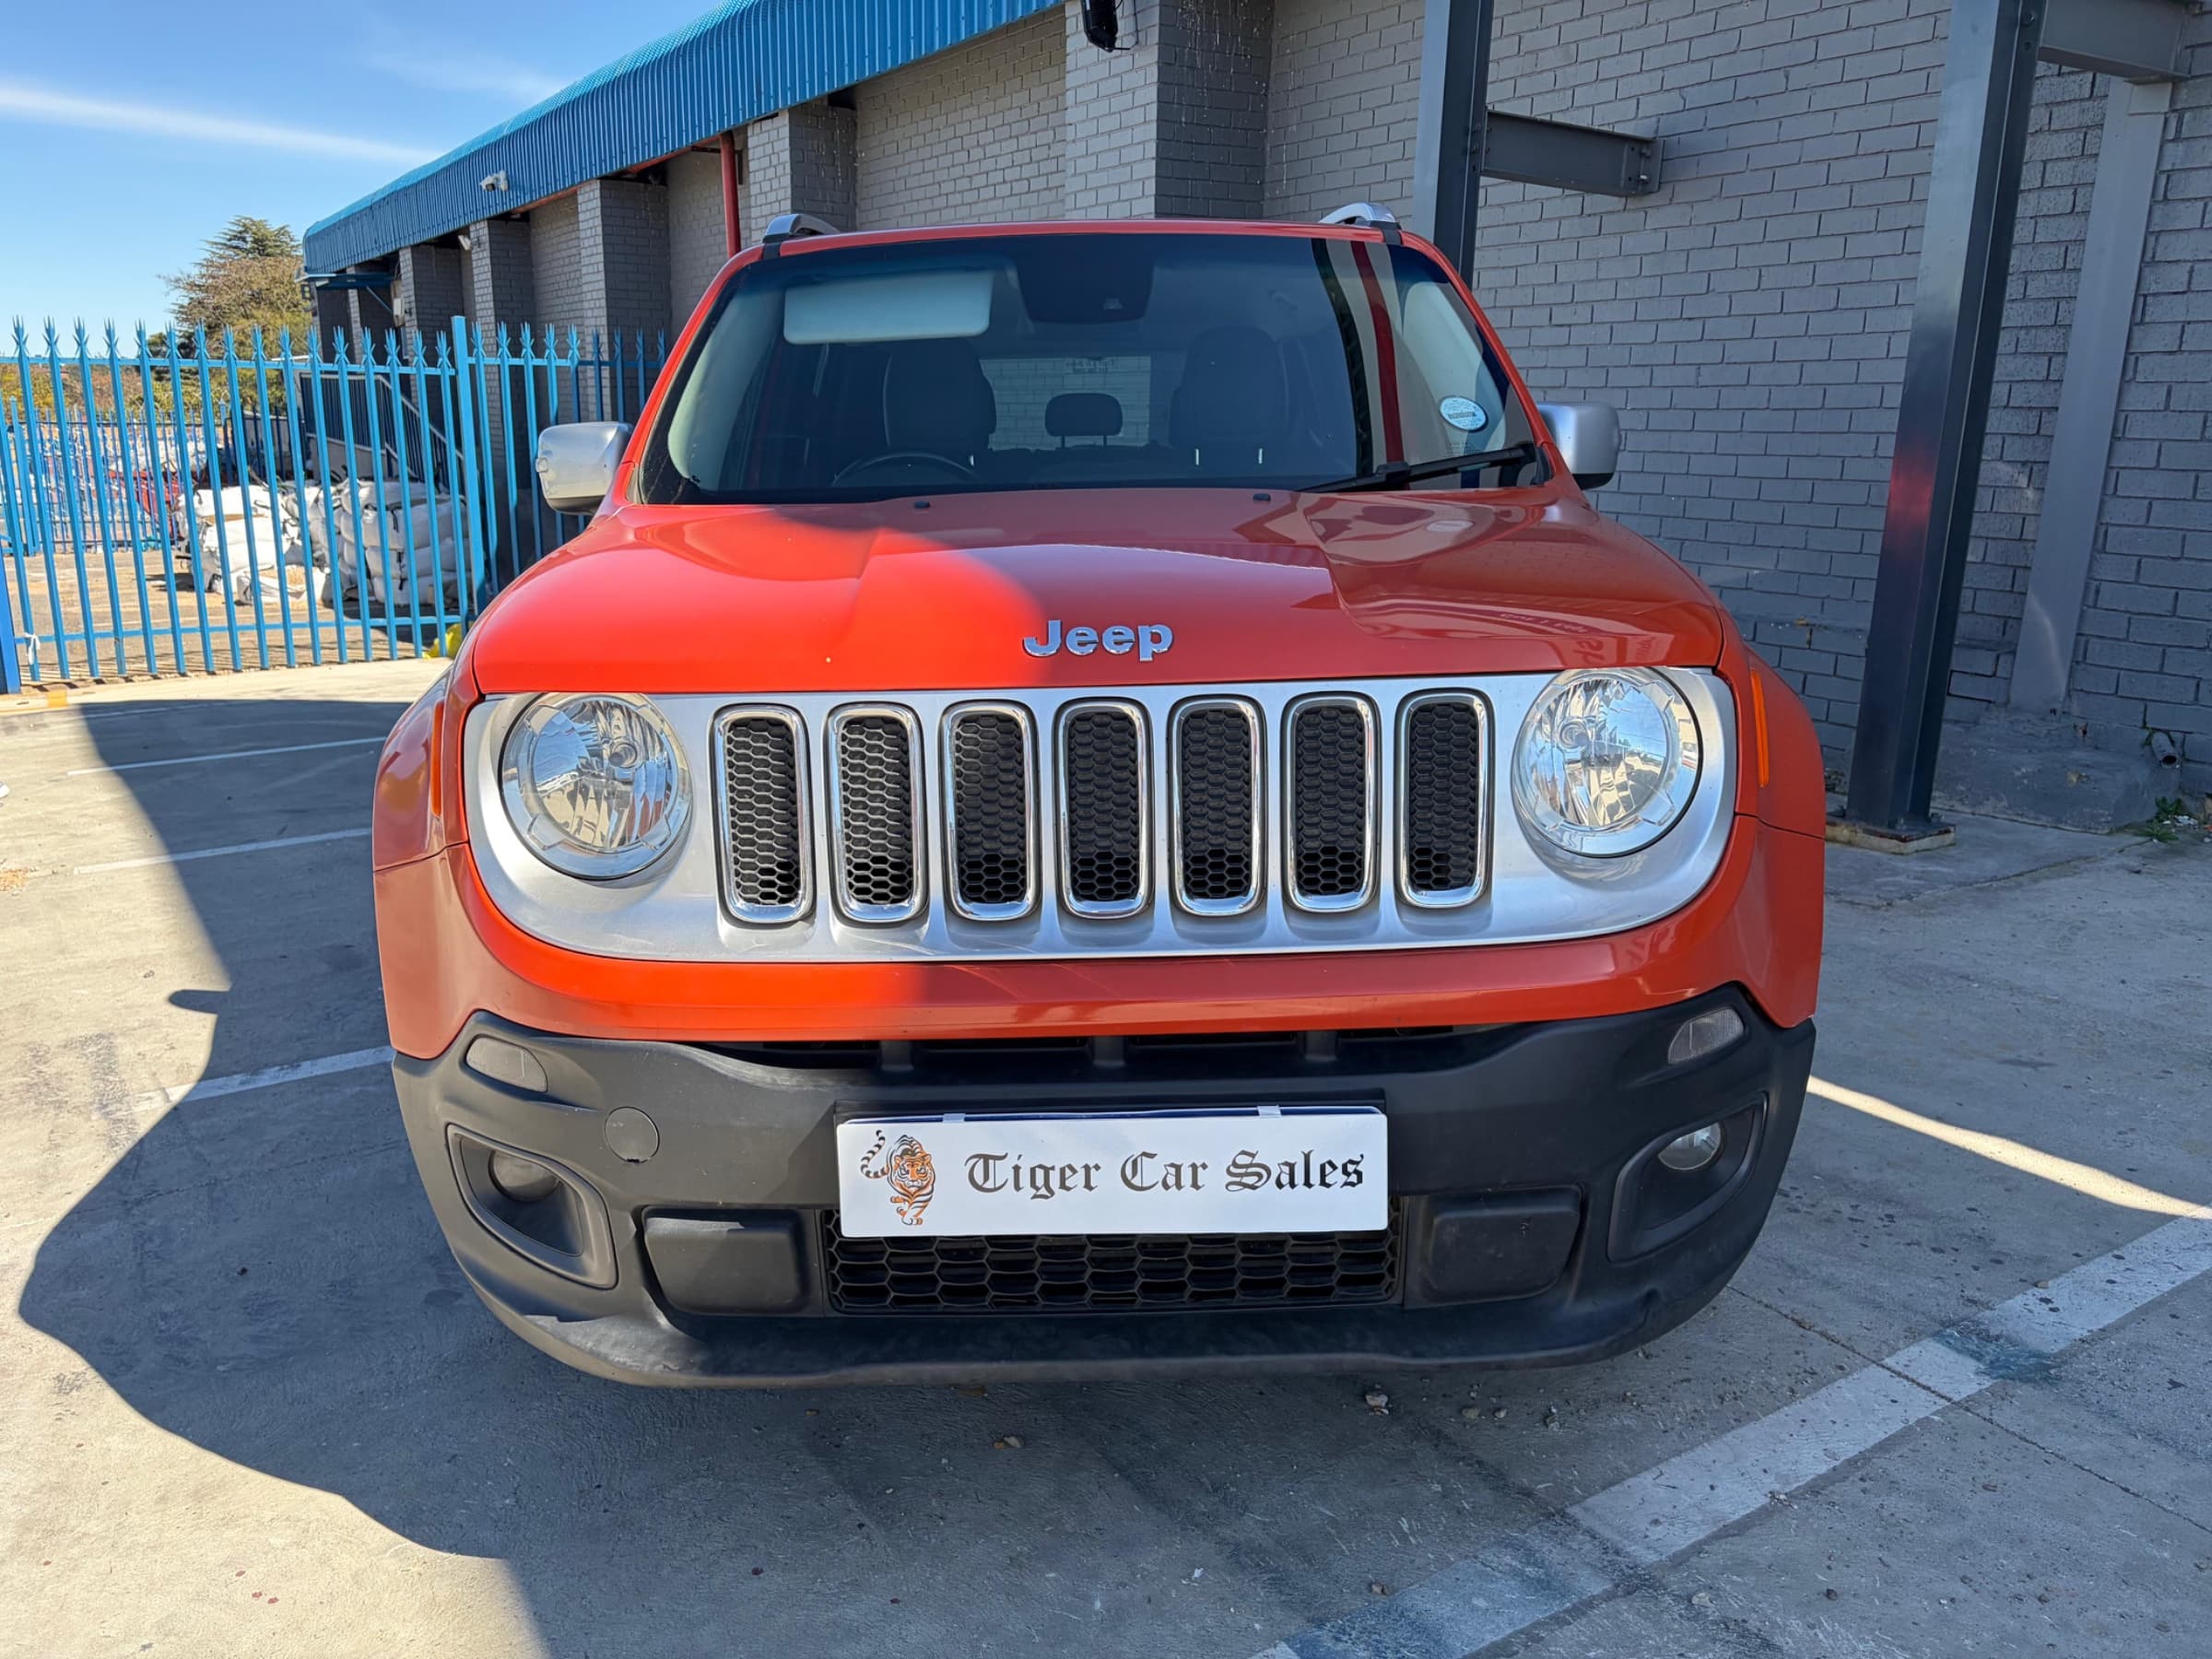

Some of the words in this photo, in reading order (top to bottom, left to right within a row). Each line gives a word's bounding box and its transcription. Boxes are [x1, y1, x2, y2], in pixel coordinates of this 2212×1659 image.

[1023, 619, 1173, 662] Jeep
[964, 1152, 1101, 1200] Tiger
[1120, 1150, 1208, 1192] Car
[1224, 1149, 1366, 1192] Sales
